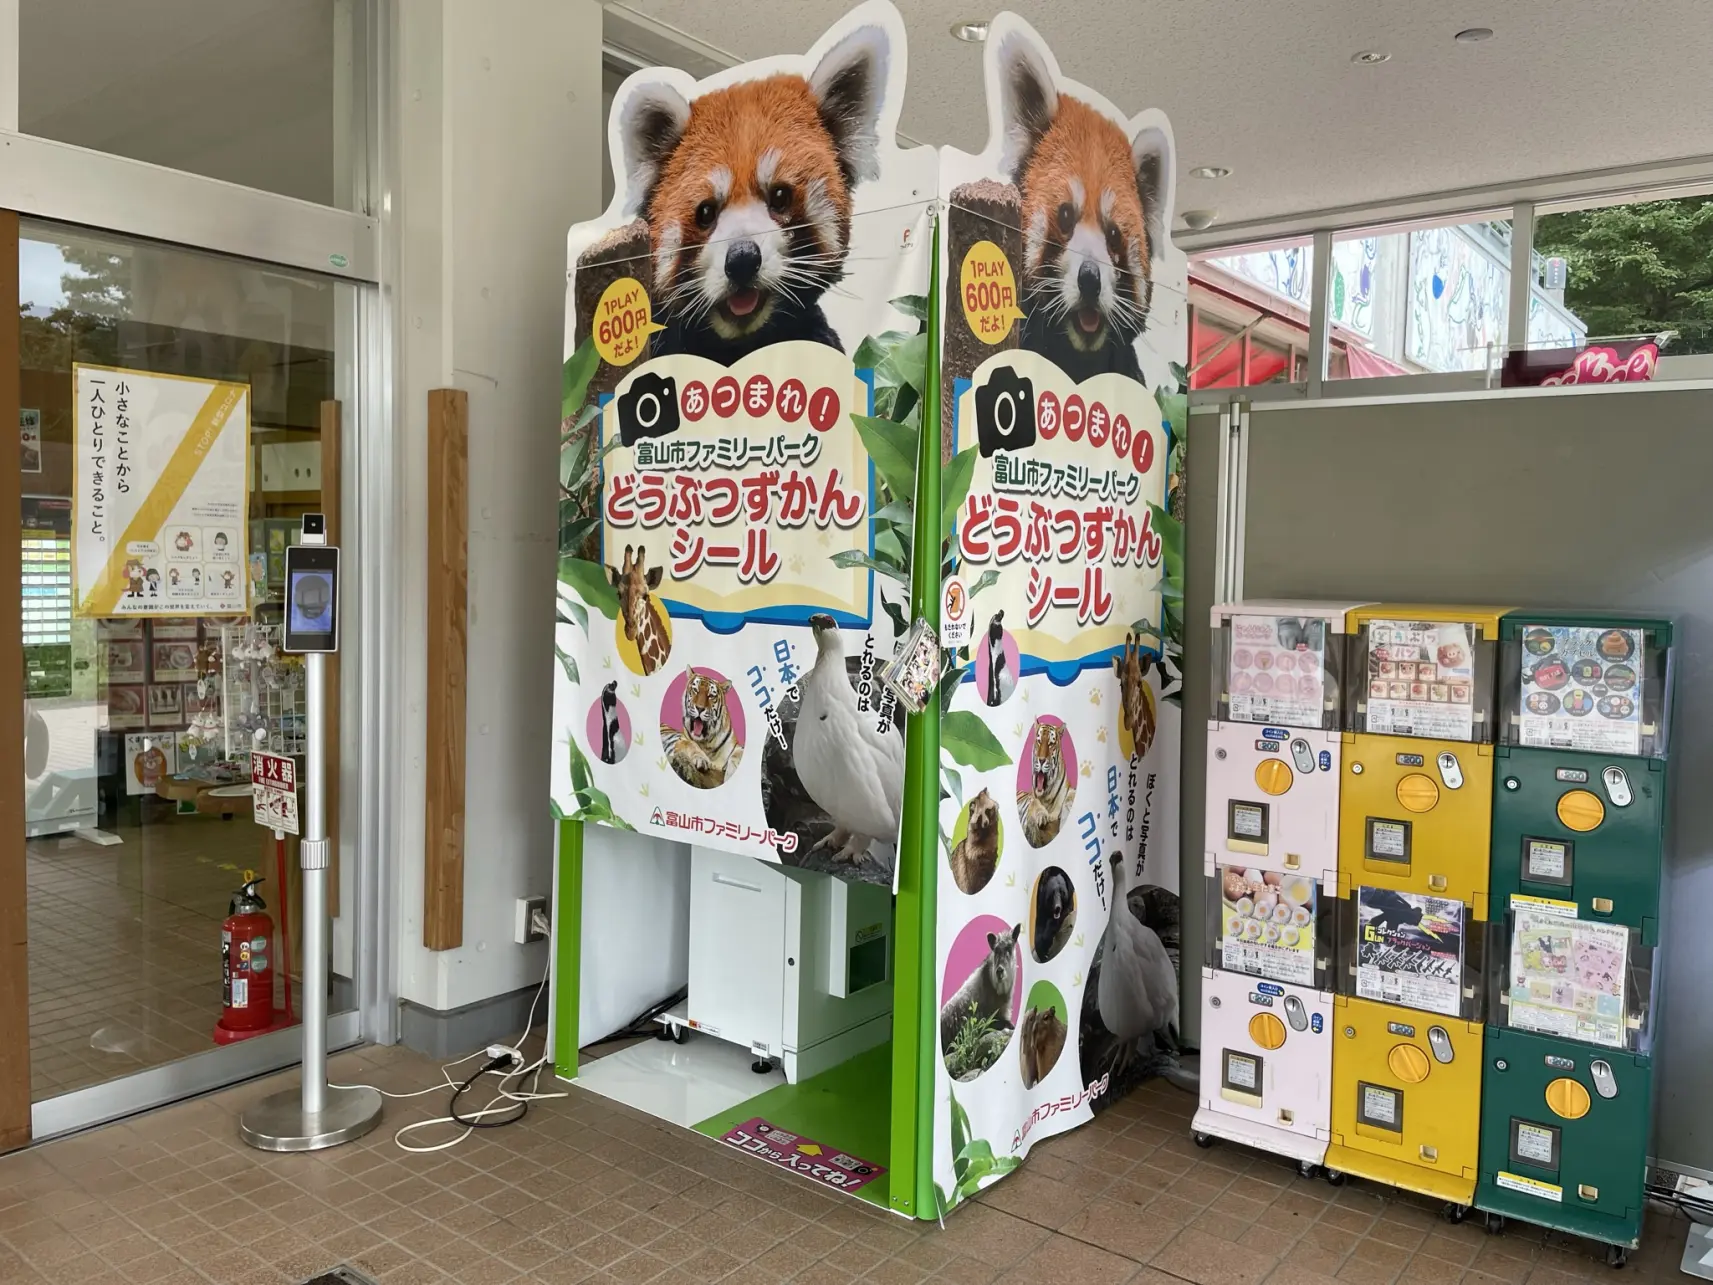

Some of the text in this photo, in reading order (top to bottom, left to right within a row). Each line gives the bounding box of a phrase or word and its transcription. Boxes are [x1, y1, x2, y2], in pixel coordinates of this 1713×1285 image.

[969, 260, 1005, 278] 1PLAY
[604, 289, 639, 316] 1PLAY
[966, 284, 1013, 312] 600円
[980, 315, 1006, 333] だよ!
[599, 310, 647, 344] 600円
[613, 336, 639, 358] だよ!
[686, 380, 831, 422] あつまれ!
[115, 380, 130, 494] 小さなことから
[637, 433, 820, 466] 富山市ファミリーパーク
[1040, 401, 1149, 464] あつまれ!
[89, 379, 107, 543] 一人ひとりできること。
[993, 455, 1140, 498] 富山市ファミリーパーク
[606, 468, 861, 523] どうぶつずかん
[671, 527, 779, 577] シール
[961, 493, 1161, 564] どうぶつずかん
[1028, 567, 1112, 623] シール
[948, 631, 963, 640] ください
[773, 639, 801, 701] 日本で
[857, 634, 875, 712] とれるのは
[746, 665, 788, 749] ココだけ!
[253, 755, 293, 783] 消火器
[1107, 766, 1122, 838] 日本で
[1126, 754, 1137, 842] とれるのは
[1136, 773, 1158, 877] ぼくと写真が
[665, 810, 798, 850] 富山市ファミリーパーク
[1078, 811, 1107, 912] ココだけ!
[726, 1130, 862, 1188] ココから入ってね!
